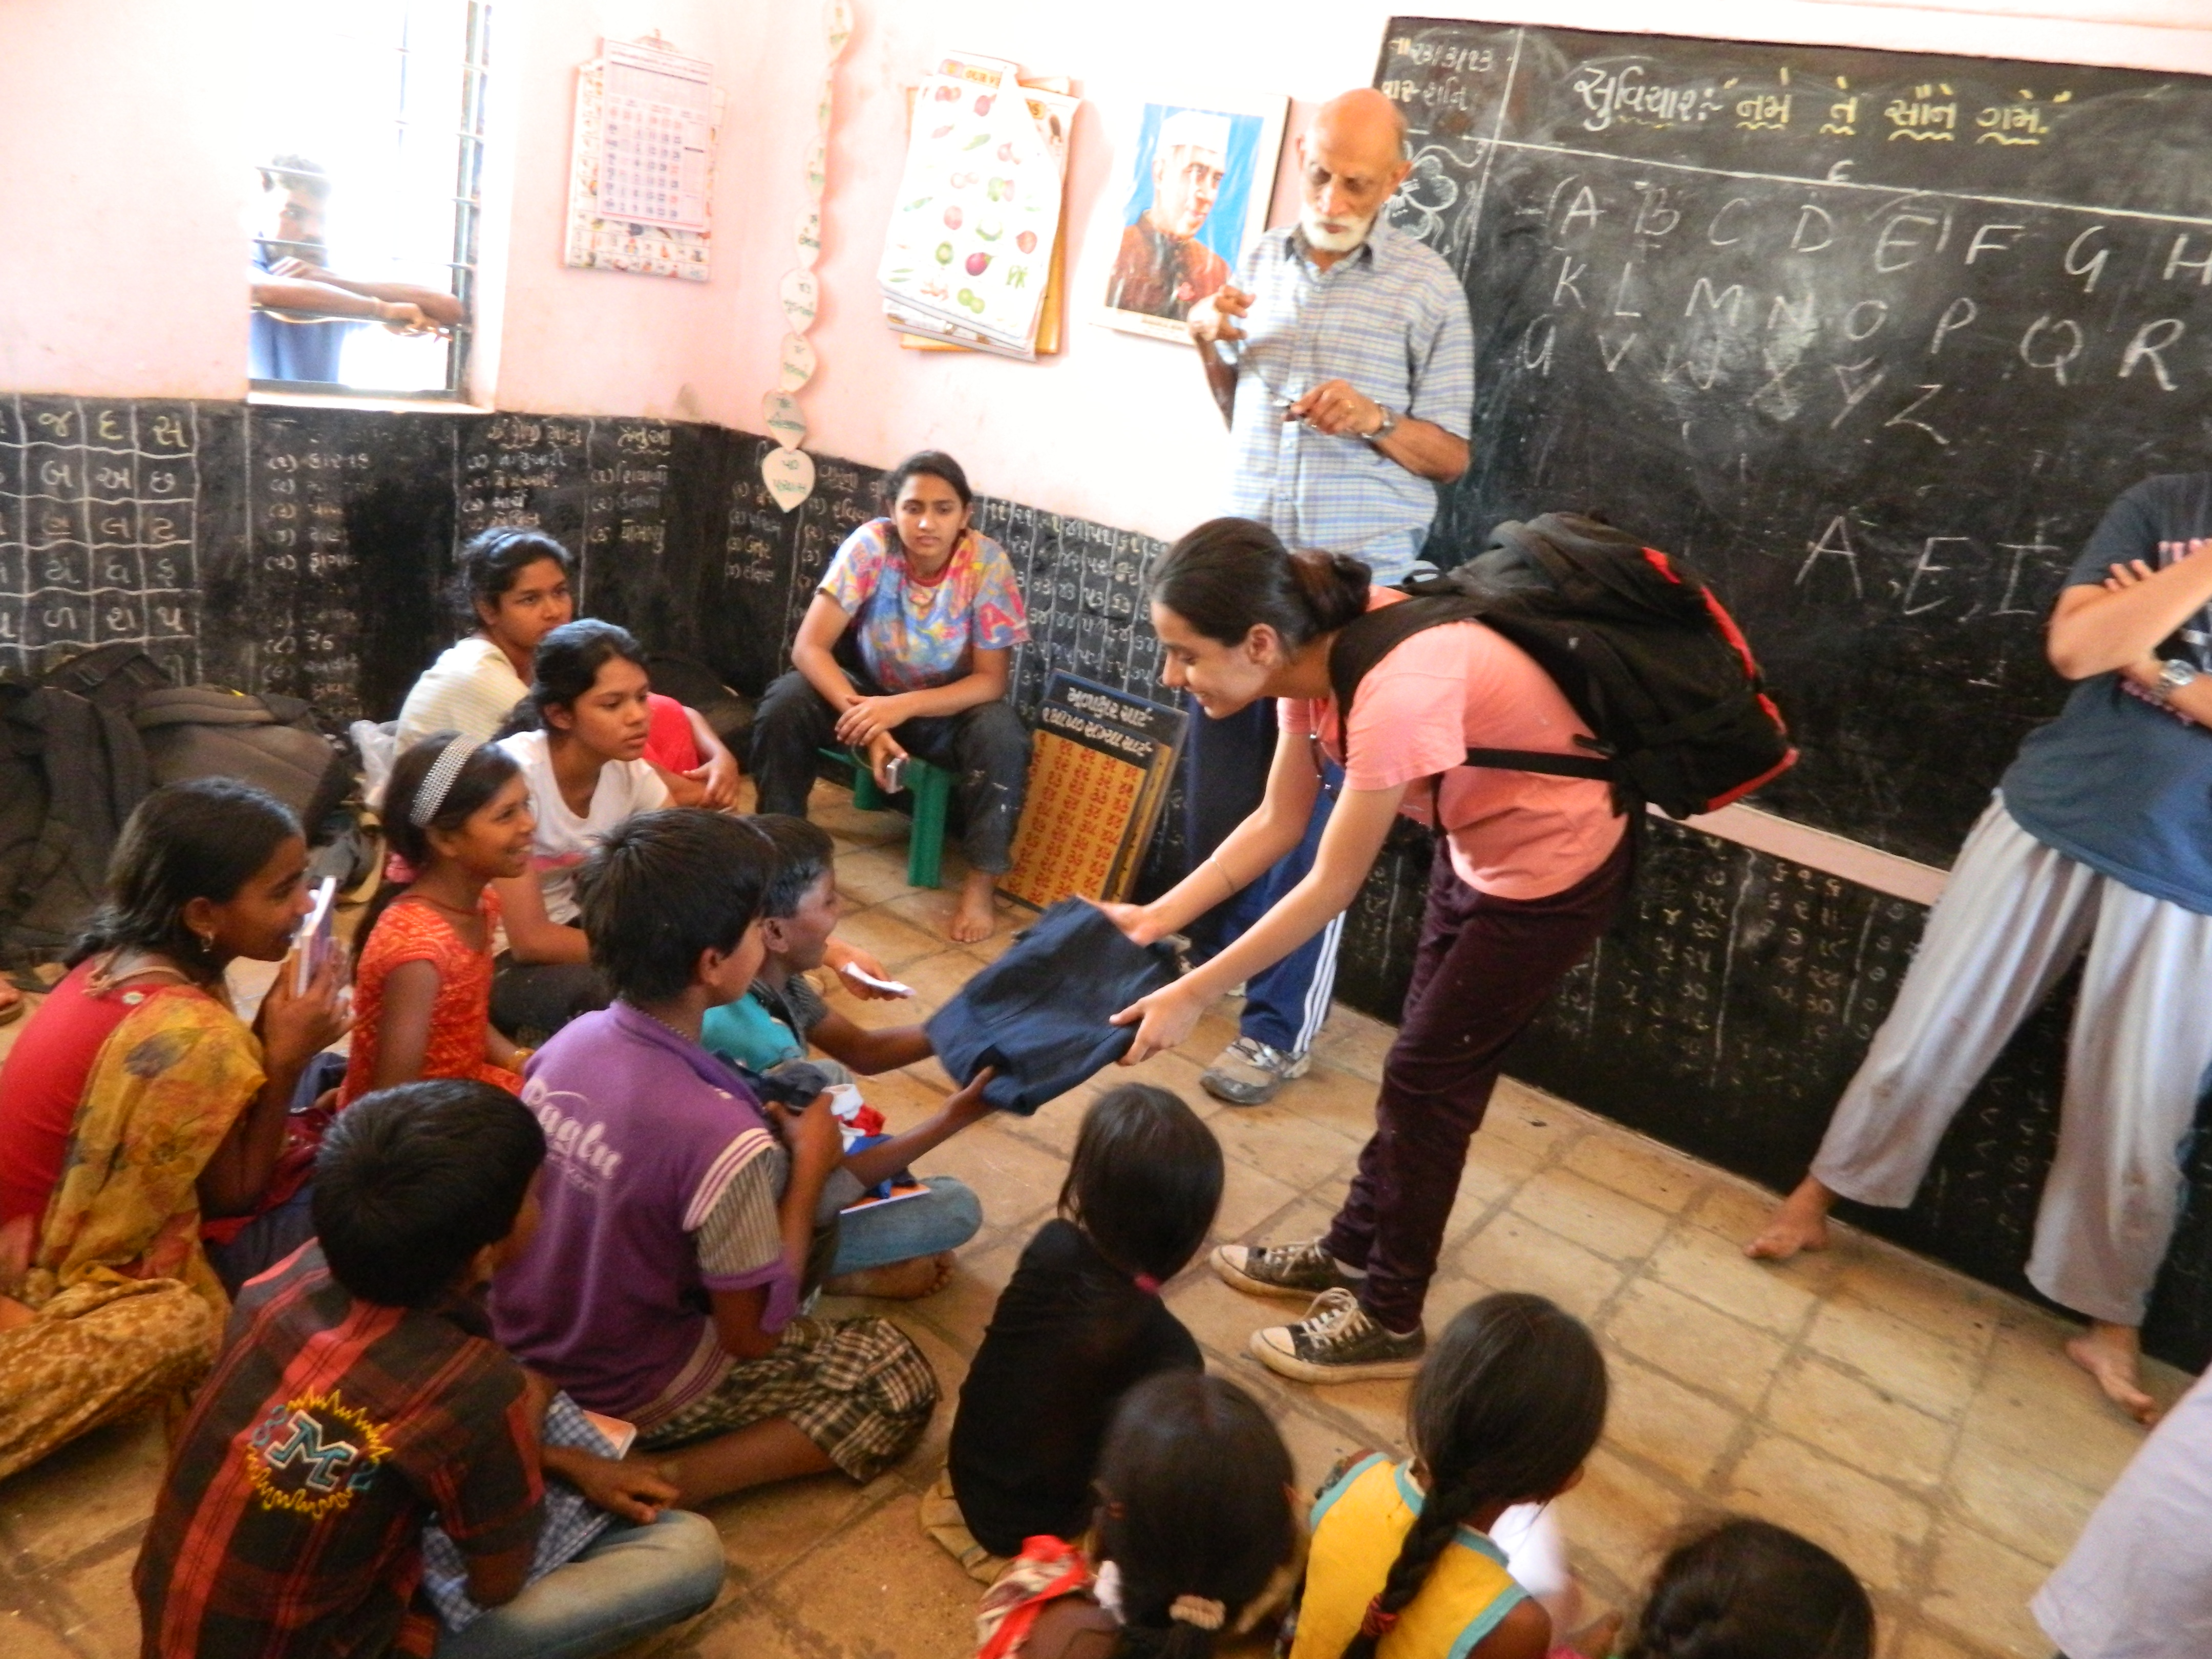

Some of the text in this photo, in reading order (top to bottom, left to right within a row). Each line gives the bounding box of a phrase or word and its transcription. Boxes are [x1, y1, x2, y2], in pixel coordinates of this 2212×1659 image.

[1560, 185, 2212, 293] A B C D E F G H
[1552, 256, 2187, 392] K L M N O P Q R
[1597, 332, 1639, 373] V
[1659, 342, 1722, 391] W
[1745, 347, 1801, 408] X
[1831, 356, 1886, 430] Y
[1884, 382, 1950, 445] Z
[1795, 515, 2061, 615] A E I
[264, 1409, 359, 1492] M
